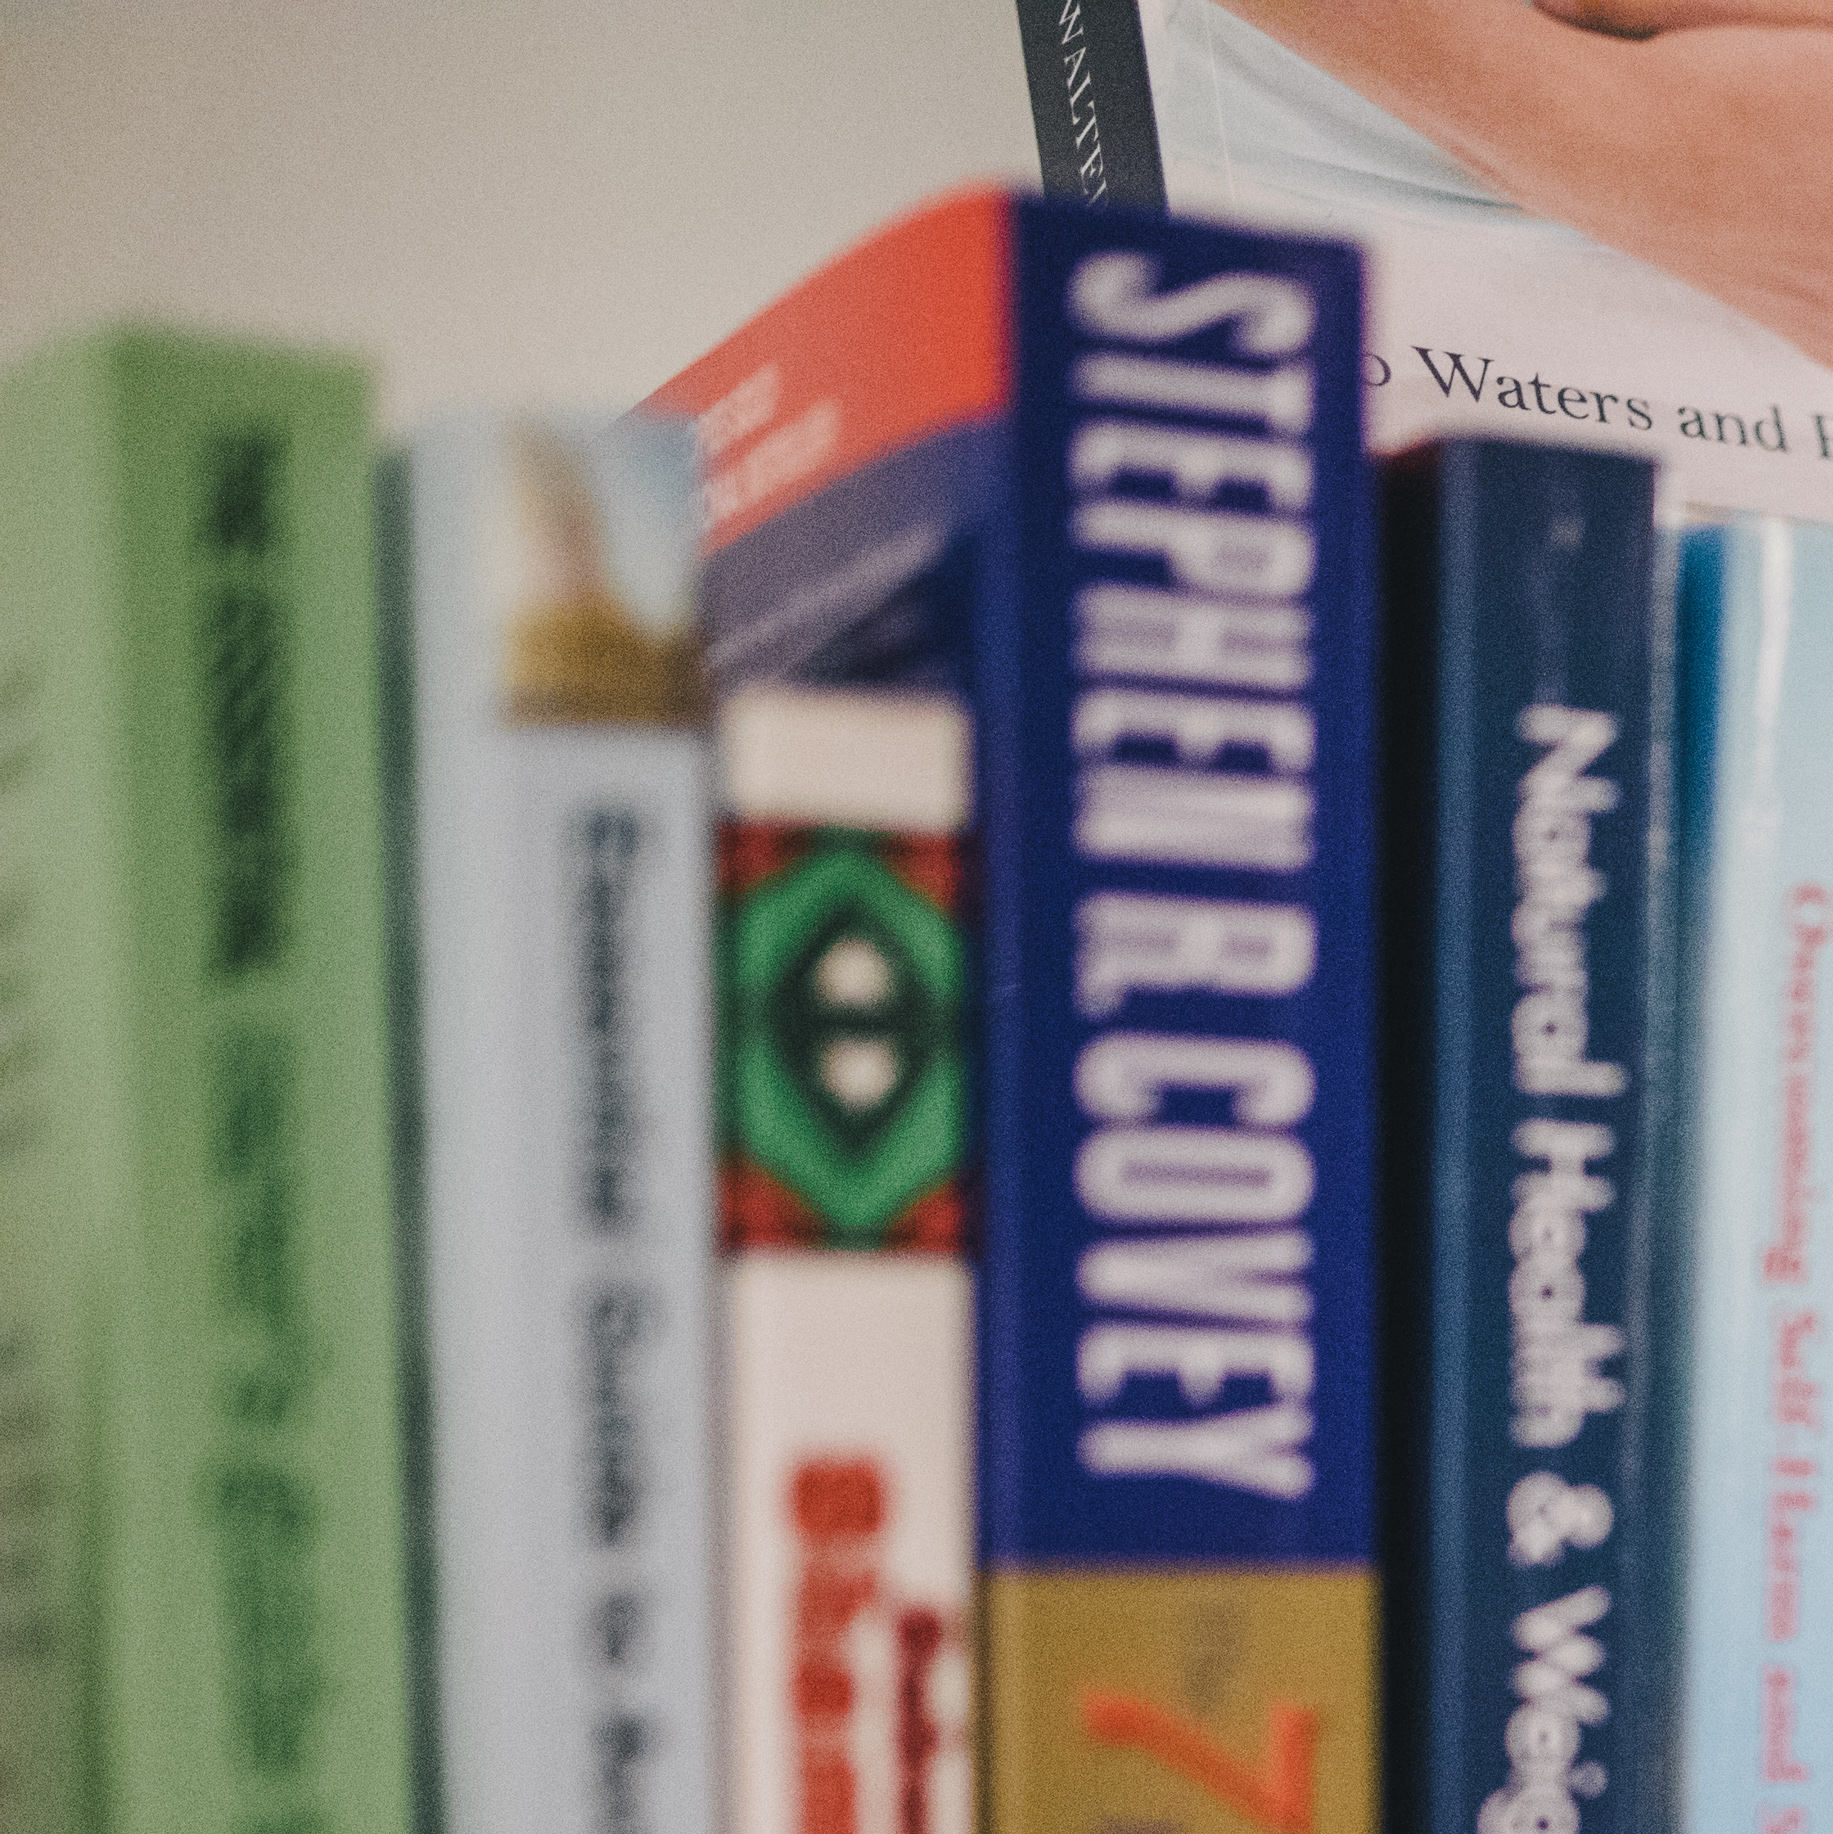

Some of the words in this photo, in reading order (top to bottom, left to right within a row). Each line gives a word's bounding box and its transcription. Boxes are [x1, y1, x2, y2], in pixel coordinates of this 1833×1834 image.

[1411, 346, 1654, 431] Waters
[1677, 403, 1788, 453] and
[1067, 252, 1315, 872] STEPHEN
[1070, 889, 1316, 1017] R
[1507, 704, 1630, 1098] Natural
[1074, 1032, 1316, 1500] COVEY
[1504, 1116, 1630, 1450] Health
[1503, 1470, 1615, 1567] &
[1753, 1664, 1815, 1786] and
